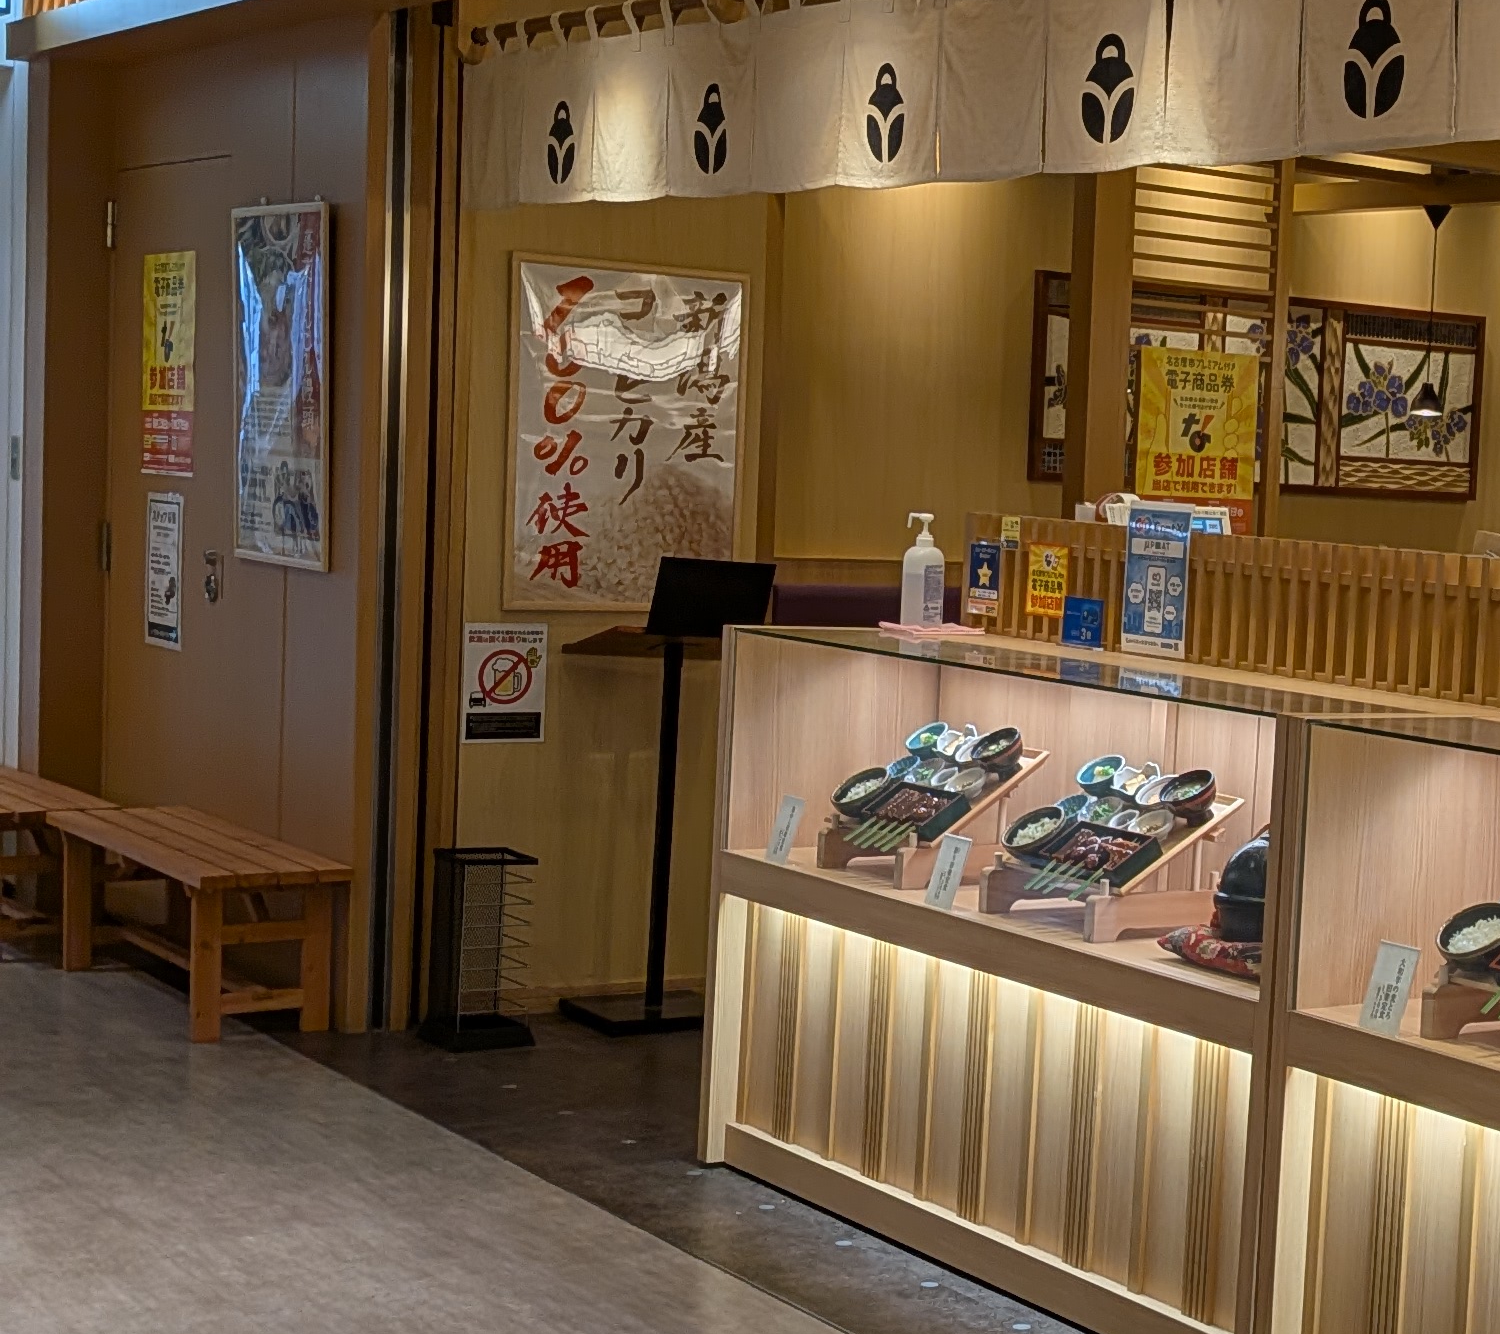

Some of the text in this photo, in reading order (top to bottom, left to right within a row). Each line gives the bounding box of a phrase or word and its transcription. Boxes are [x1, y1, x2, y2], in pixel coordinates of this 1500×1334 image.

[1165, 369, 1236, 394] 電子商品券
[609, 288, 656, 506] コヒカリ
[1153, 452, 1239, 480] 参加店舗
